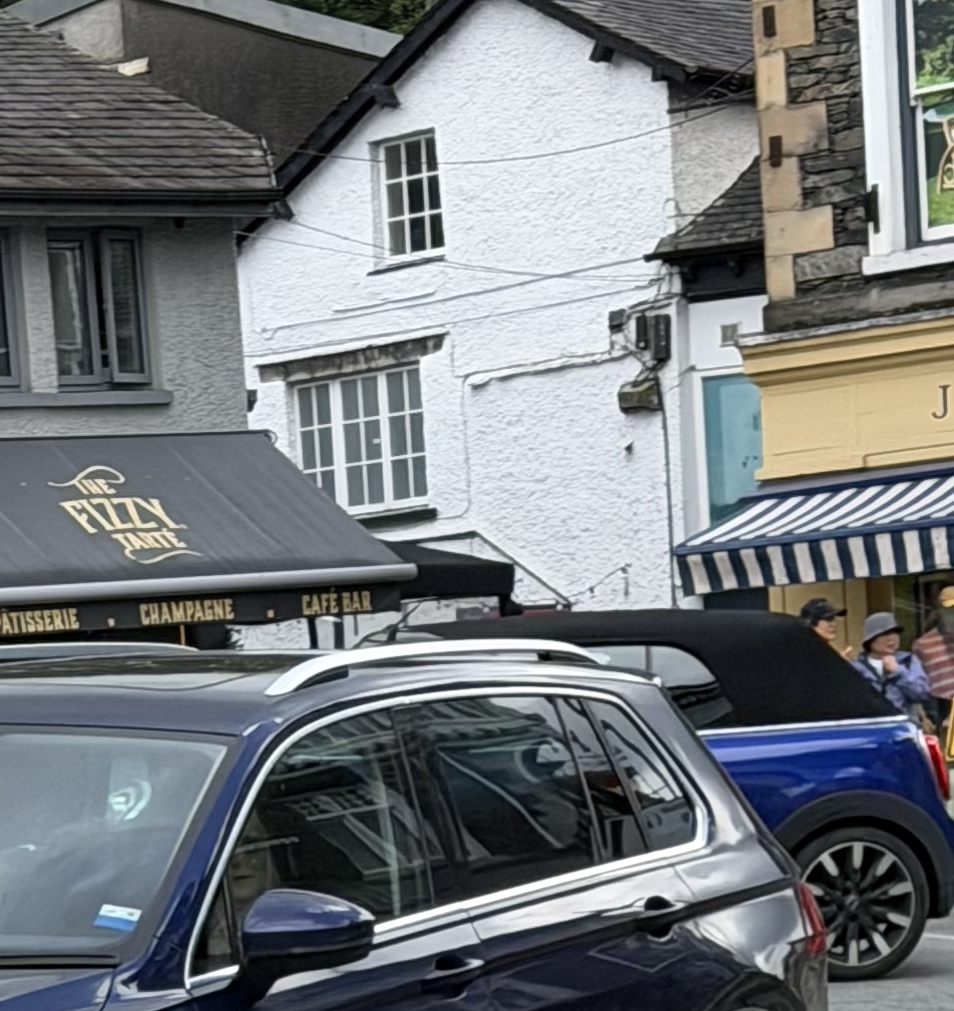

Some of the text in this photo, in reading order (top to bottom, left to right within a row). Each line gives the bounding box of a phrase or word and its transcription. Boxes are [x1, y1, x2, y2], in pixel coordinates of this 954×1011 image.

[59, 497, 188, 534] FIZZY
[139, 598, 235, 625] CHAMPAGNE
[342, 591, 373, 612] BAR
